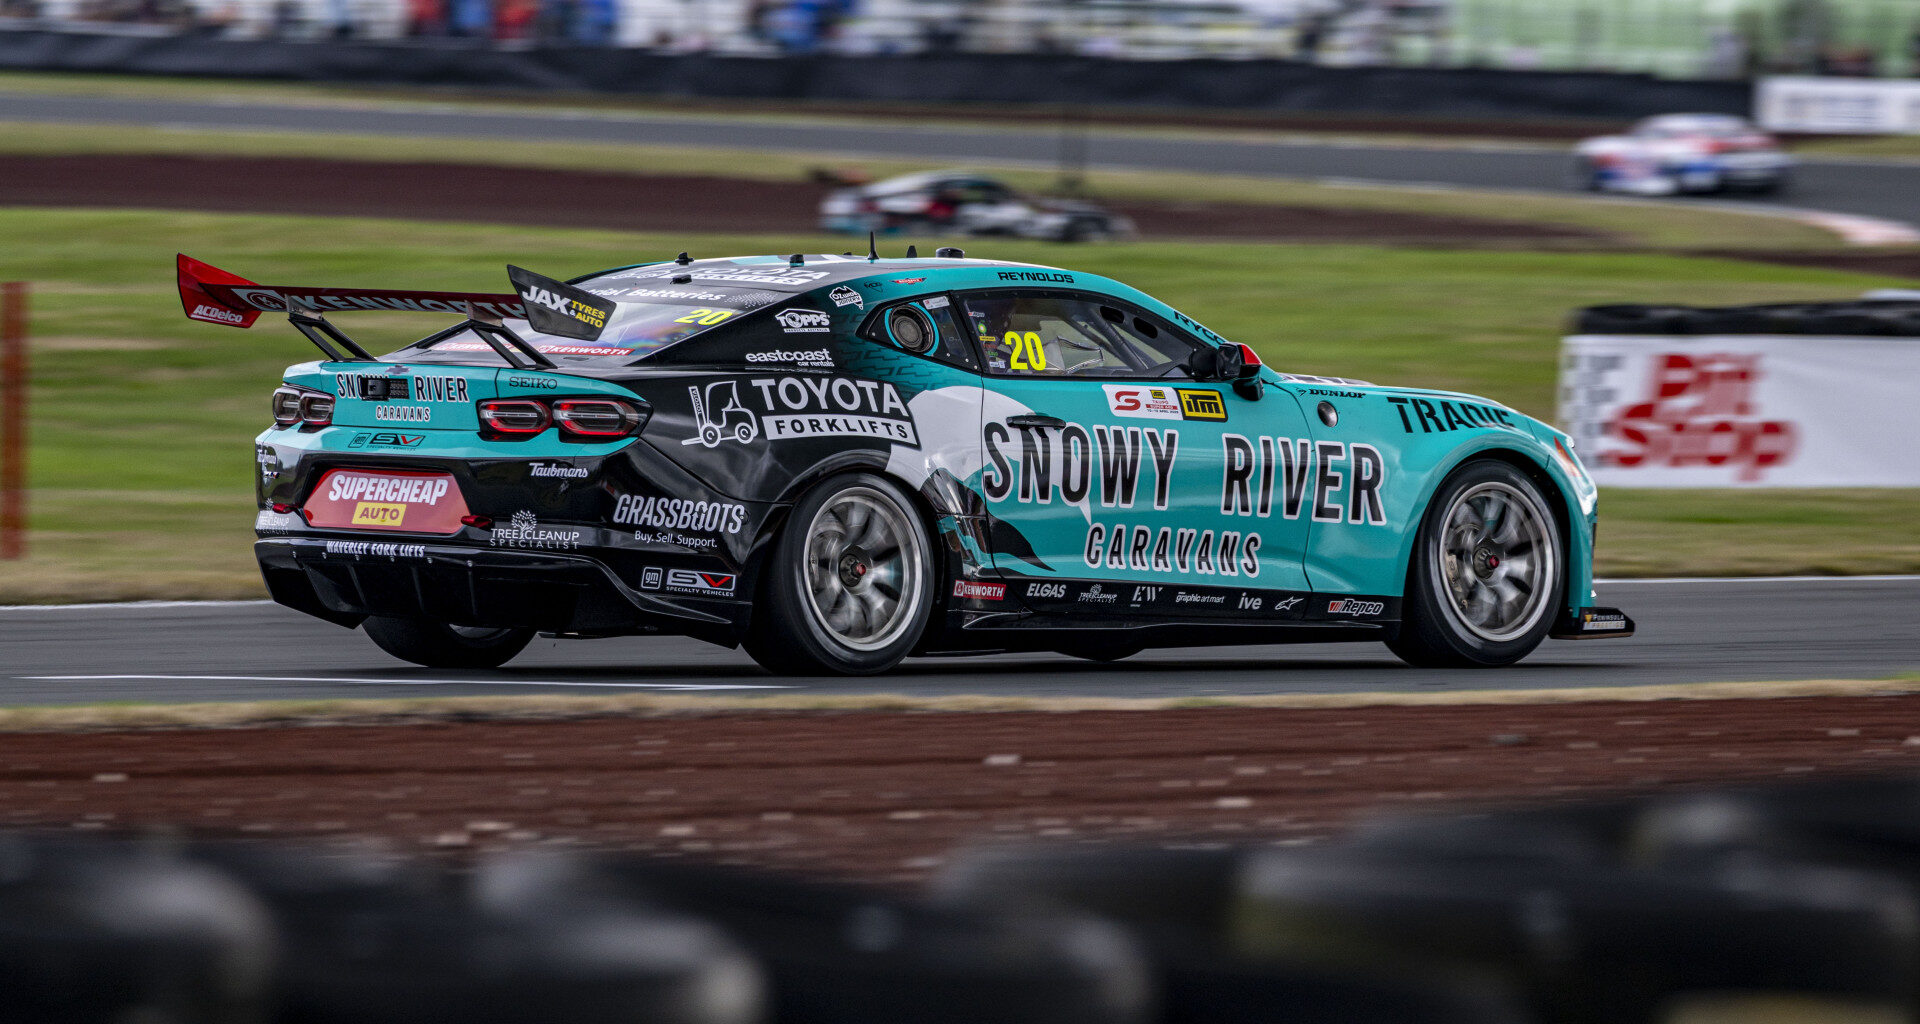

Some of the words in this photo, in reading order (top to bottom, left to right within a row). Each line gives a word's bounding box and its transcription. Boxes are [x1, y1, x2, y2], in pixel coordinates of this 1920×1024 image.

[997, 272, 1075, 284] REYNOLDS
[522, 286, 573, 316] JAX
[626, 287, 727, 301] Batteries
[192, 304, 243, 323] ACDelco
[571, 300, 606, 319] TYRES
[673, 308, 733, 326] 20
[575, 312, 604, 328] AUTO
[552, 346, 630, 355] KENWORTH
[745, 348, 832, 362] eastcoast
[1004, 331, 1047, 371] 20
[336, 372, 390, 399] SNO
[413, 375, 470, 402] RIVER
[508, 376, 558, 390] SEIKO
[750, 376, 910, 417] TOYOTA
[1308, 388, 1367, 399] DUNLOP
[375, 404, 431, 422] CARAVANS
[774, 418, 909, 439] FORKLIFTS
[528, 462, 588, 478] Taubmans
[982, 421, 1180, 511] SNOWY
[1219, 432, 1388, 526] RIVER
[328, 474, 449, 506] SUPERCHEAP
[359, 507, 400, 521] AUTO
[490, 528, 520, 539] TREE
[524, 530, 580, 541] CLEANUP
[634, 530, 655, 543] Buy.
[656, 531, 675, 544] Sell.
[676, 534, 718, 548] Support.
[326, 540, 368, 556] WAVERLEY
[370, 542, 397, 556] FORK
[400, 544, 425, 557] LIFTS
[489, 538, 580, 549] SPECIALIST
[1084, 523, 1262, 578] CARAVANS
[666, 586, 700, 594] SPECIALTY
[702, 589, 734, 597] VEHICLES
[963, 585, 1004, 598] KENWORTH
[1026, 583, 1067, 598] ELGAS
[1175, 593, 1201, 604] graphic
[1238, 592, 1263, 610] ive
[1342, 599, 1385, 616] Repco
